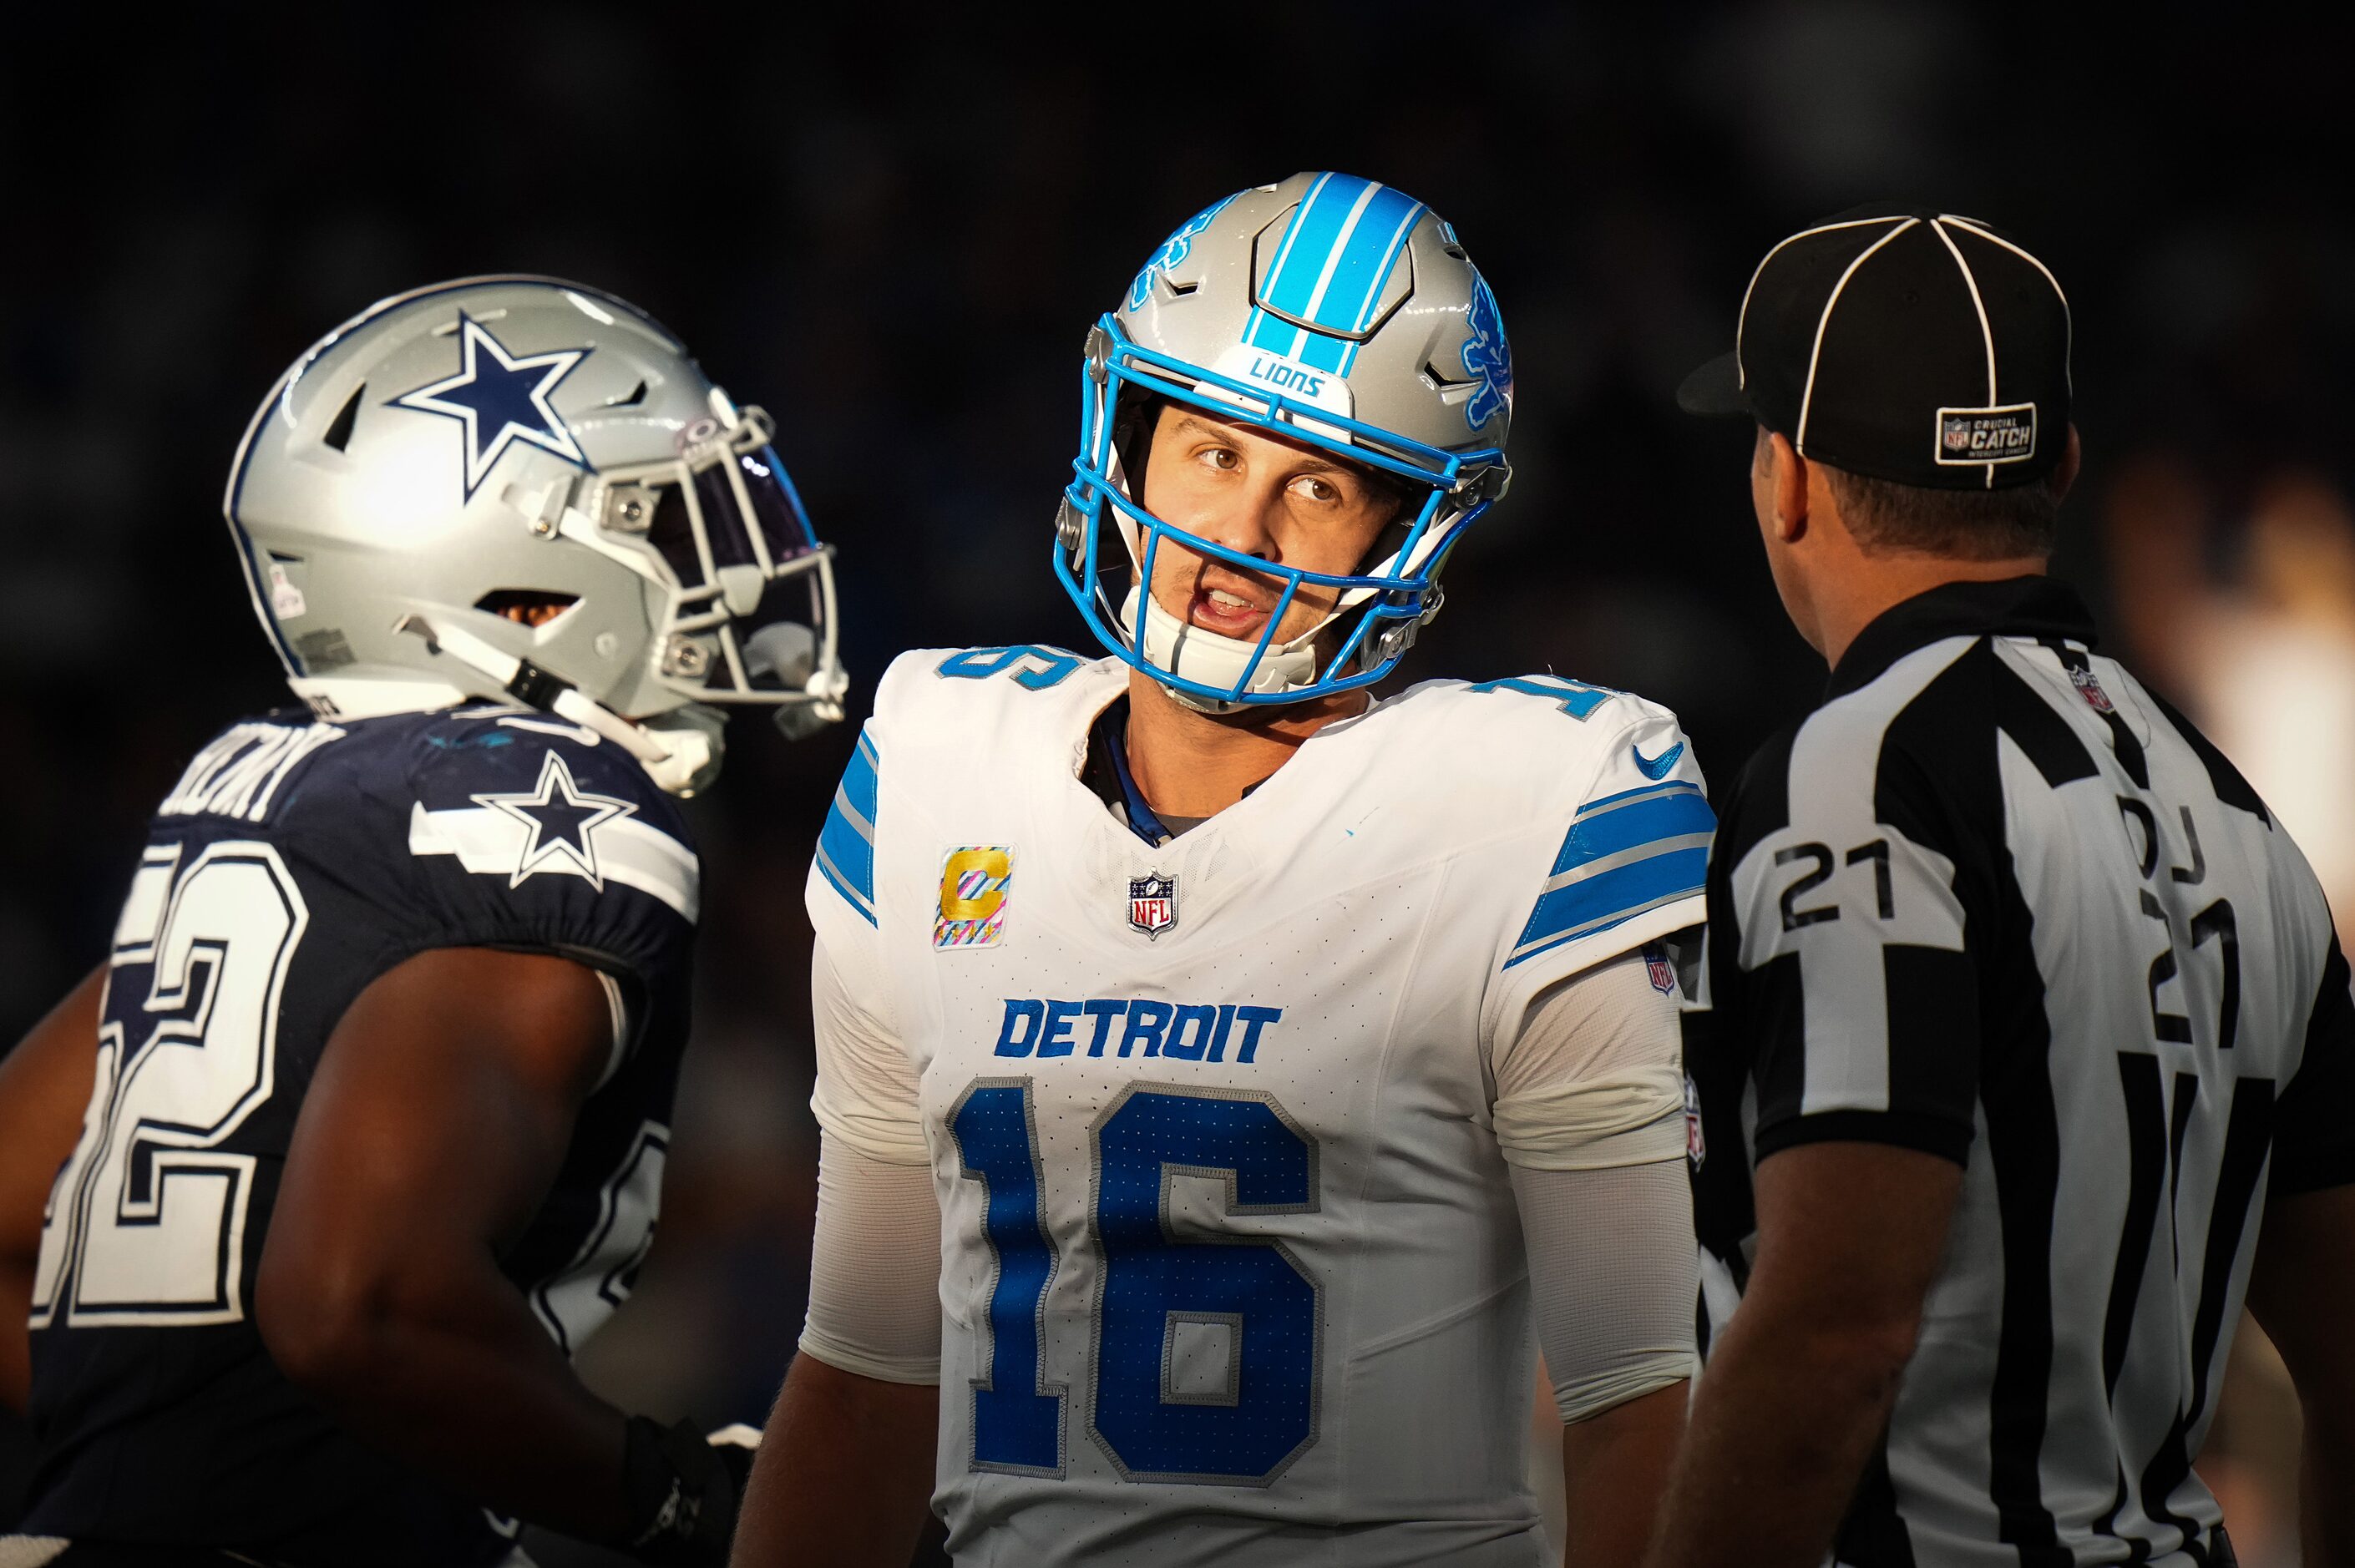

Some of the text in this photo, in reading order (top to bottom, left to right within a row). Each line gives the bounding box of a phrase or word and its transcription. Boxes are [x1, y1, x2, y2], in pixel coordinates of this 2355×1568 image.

[1249, 357, 1326, 398] LIONS
[1947, 432, 1969, 446] NFL
[1970, 426, 2031, 450] CATCH
[1973, 417, 2018, 430] CRUCIAL
[940, 850, 1009, 921] C
[1775, 837, 1896, 933] 21
[1134, 899, 1170, 927] NFL
[1649, 962, 1674, 989] NFL
[993, 999, 1284, 1065] DETROIT
[945, 1075, 1325, 1490] 16
